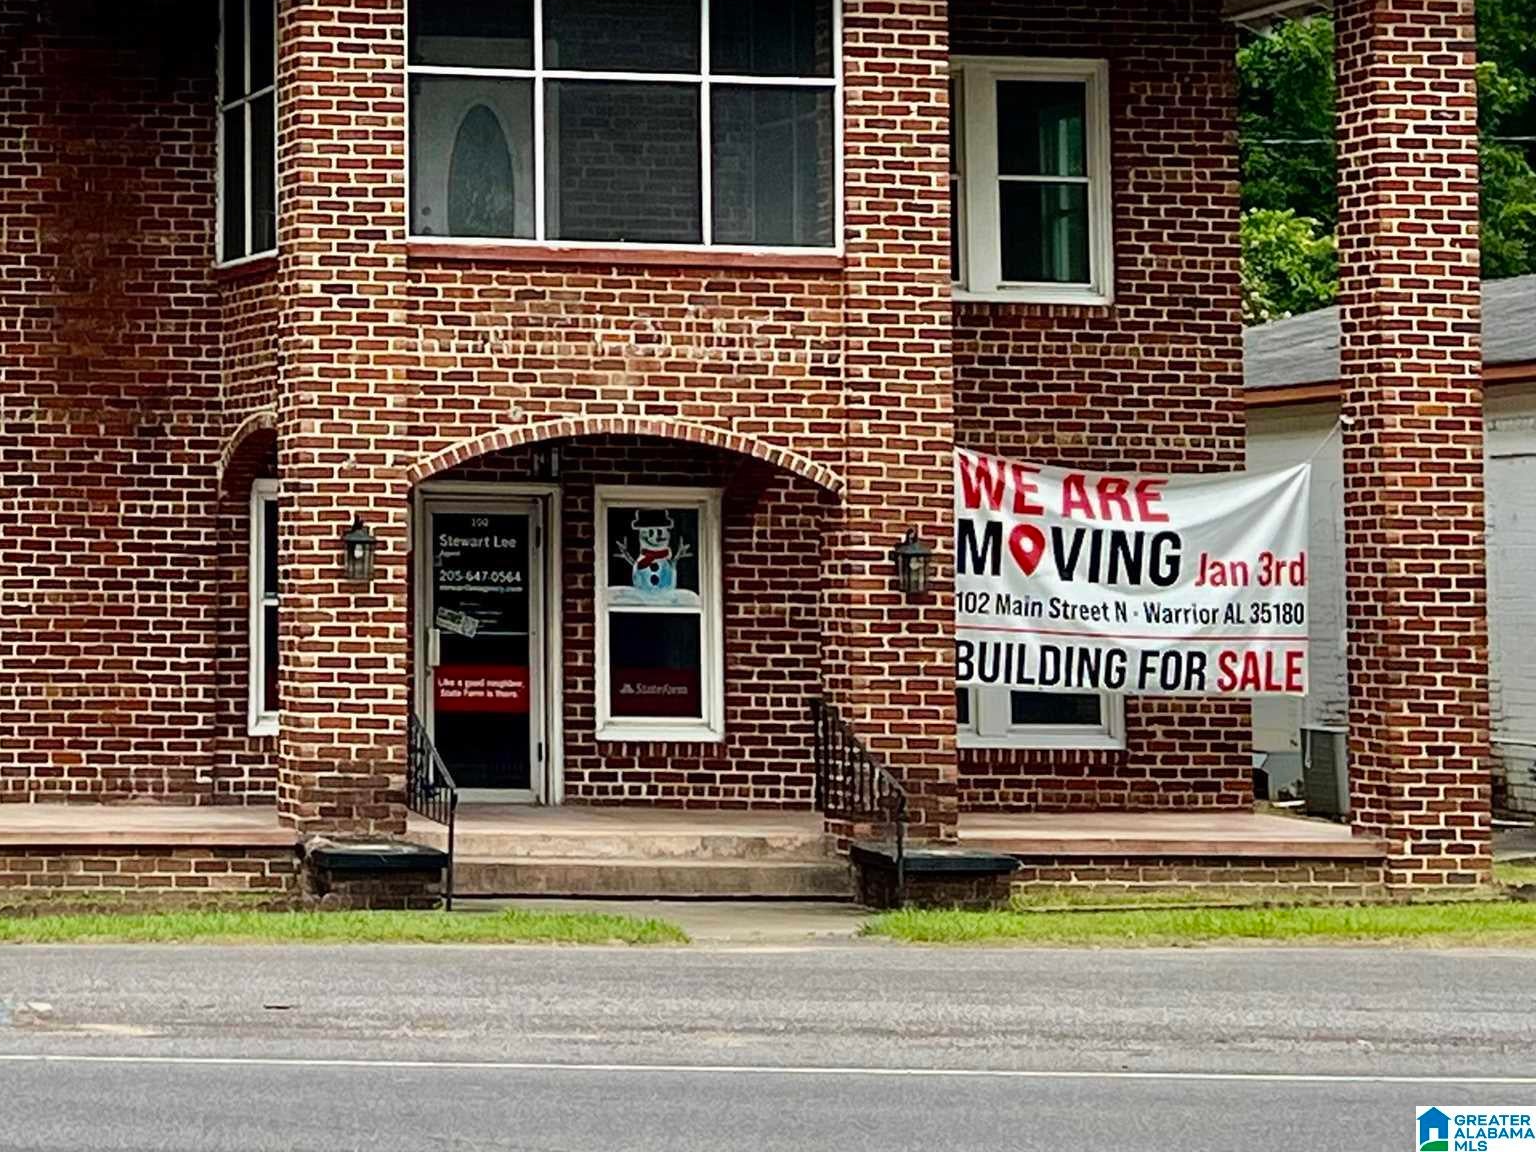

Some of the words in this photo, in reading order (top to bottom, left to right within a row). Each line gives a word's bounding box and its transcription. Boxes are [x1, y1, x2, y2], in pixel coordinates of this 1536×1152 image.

[958, 453, 1044, 516] WE
[1061, 473, 1169, 523] ARE
[439, 533, 490, 547] Stewart
[493, 535, 517, 548] Lee
[1194, 552, 1249, 587] Jan
[1257, 551, 1305, 587] 3rd
[957, 591, 990, 614] 102
[995, 593, 1043, 618] Main
[1048, 597, 1110, 622] Street
[1115, 601, 1128, 623] N
[1143, 601, 1220, 625] Warrior
[1223, 602, 1245, 625] AL
[1250, 602, 1305, 625] 35180
[955, 639, 1127, 690] BUILDING
[1138, 649, 1207, 691] FOR
[1217, 650, 1304, 692] SALE
[439, 688, 463, 697] State
[464, 688, 485, 697] Farm
